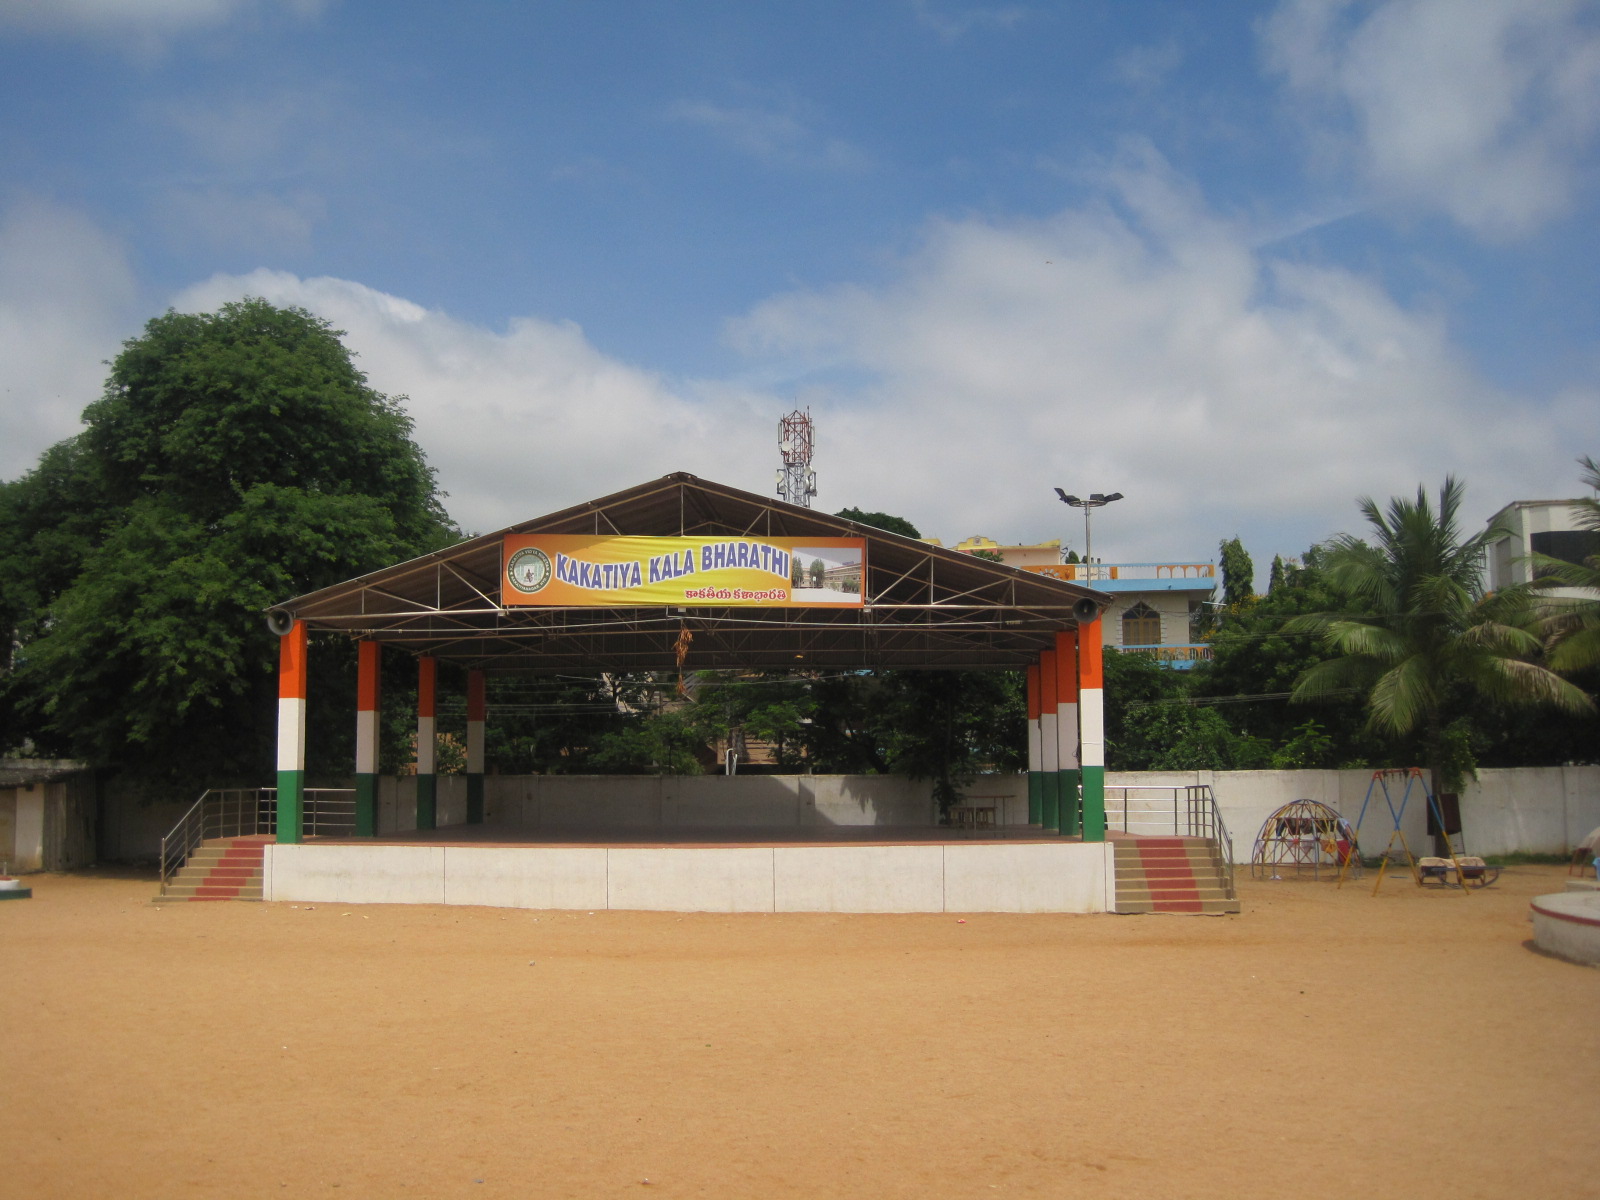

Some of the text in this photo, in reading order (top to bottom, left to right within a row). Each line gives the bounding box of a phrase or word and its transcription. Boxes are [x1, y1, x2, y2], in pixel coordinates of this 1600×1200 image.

[557, 542, 789, 590] KAKATIYA KALA BHARATHI
[685, 586, 731, 599] కాకతీయ
